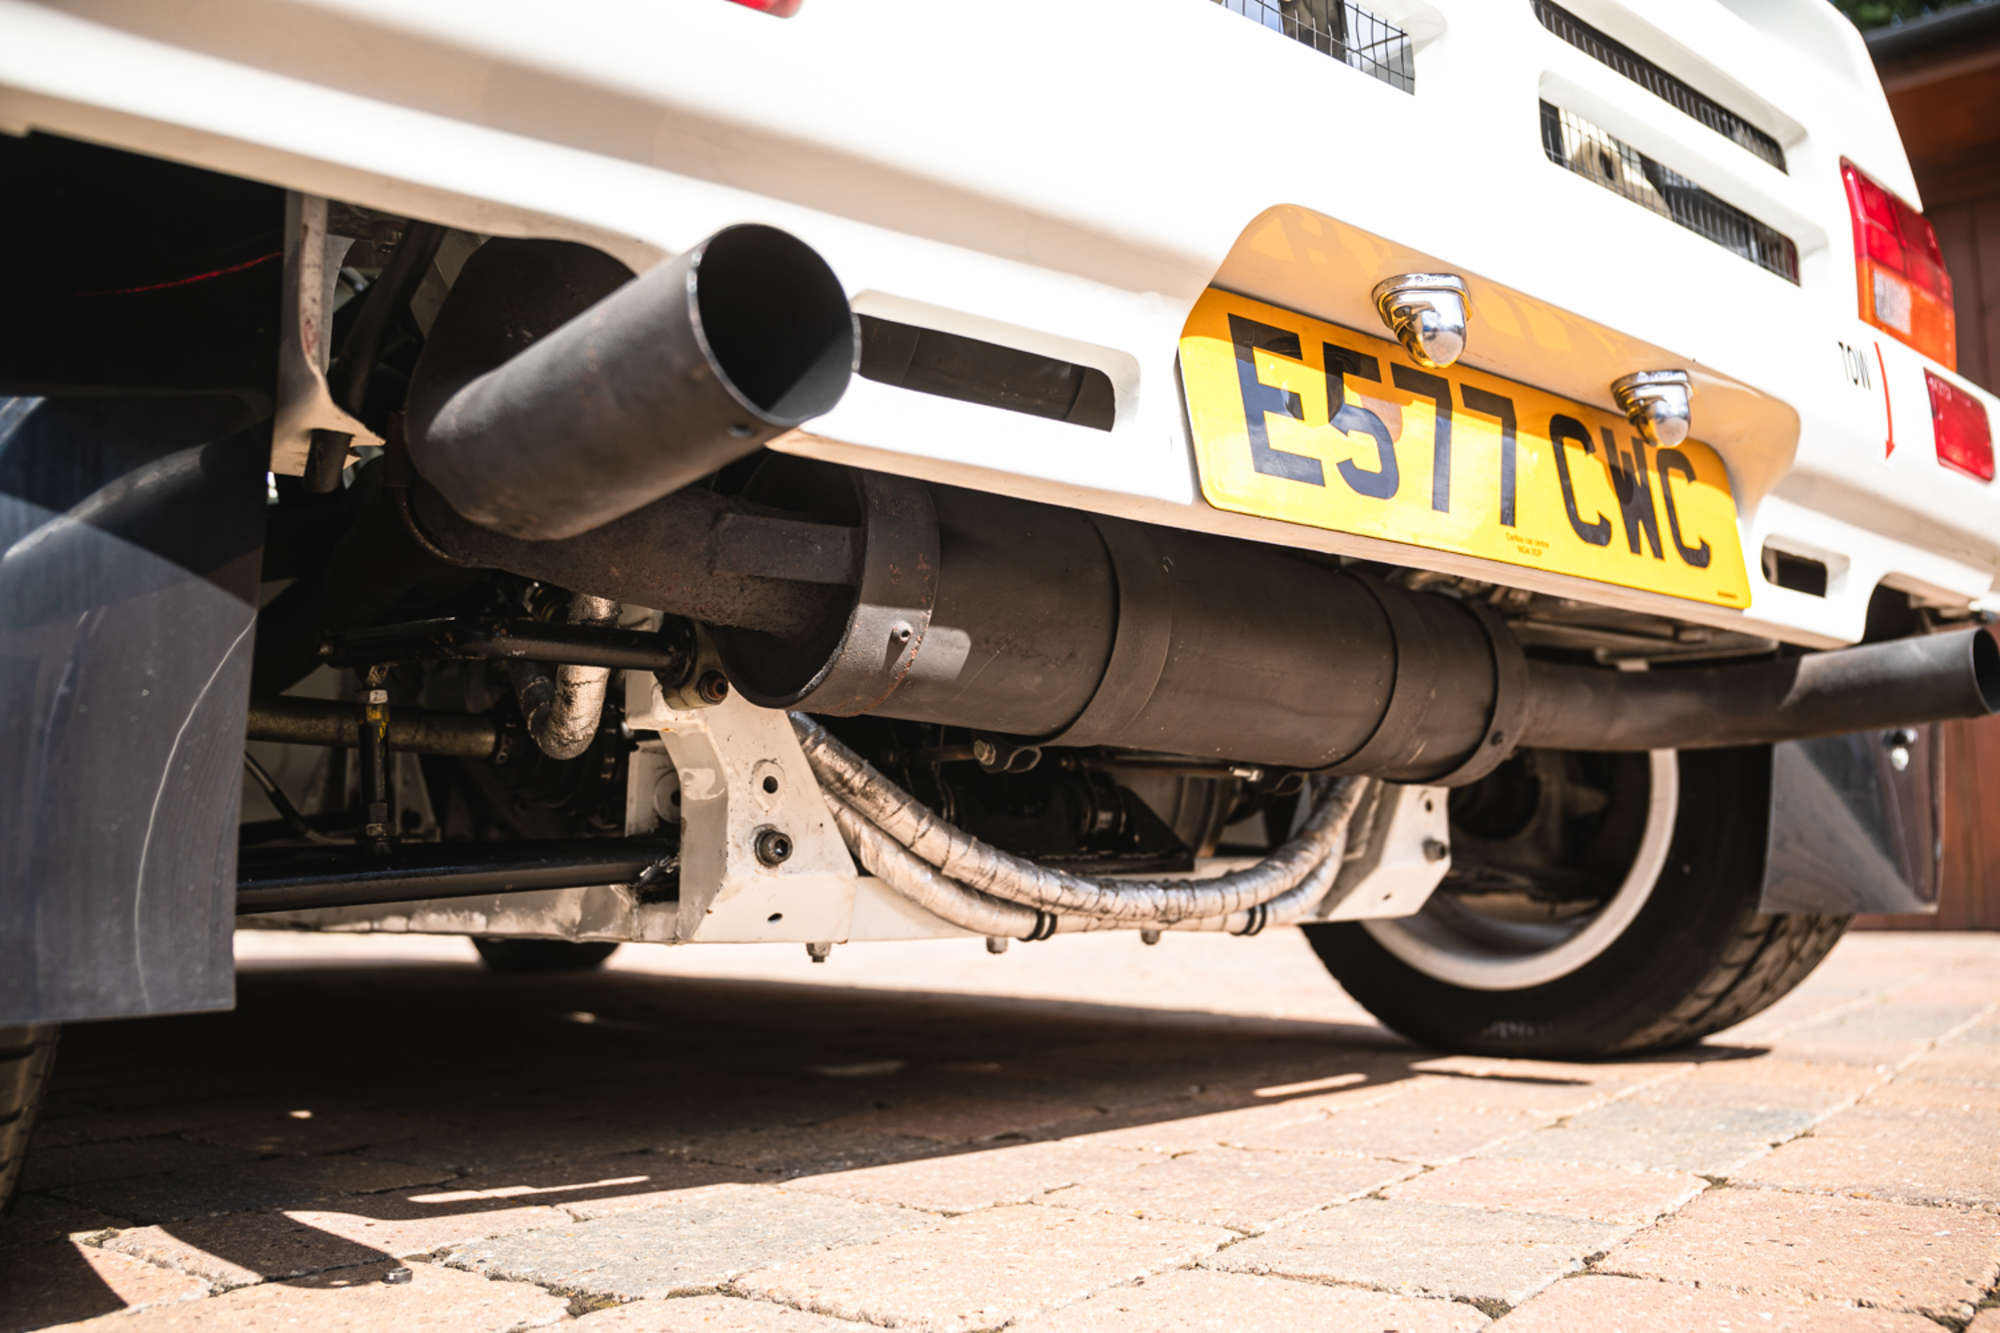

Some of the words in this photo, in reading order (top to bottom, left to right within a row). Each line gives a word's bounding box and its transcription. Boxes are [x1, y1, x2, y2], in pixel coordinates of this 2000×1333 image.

[1228, 313, 1516, 528] E577
[1550, 414, 1712, 569] CWC
[1838, 341, 1871, 390] TOW
